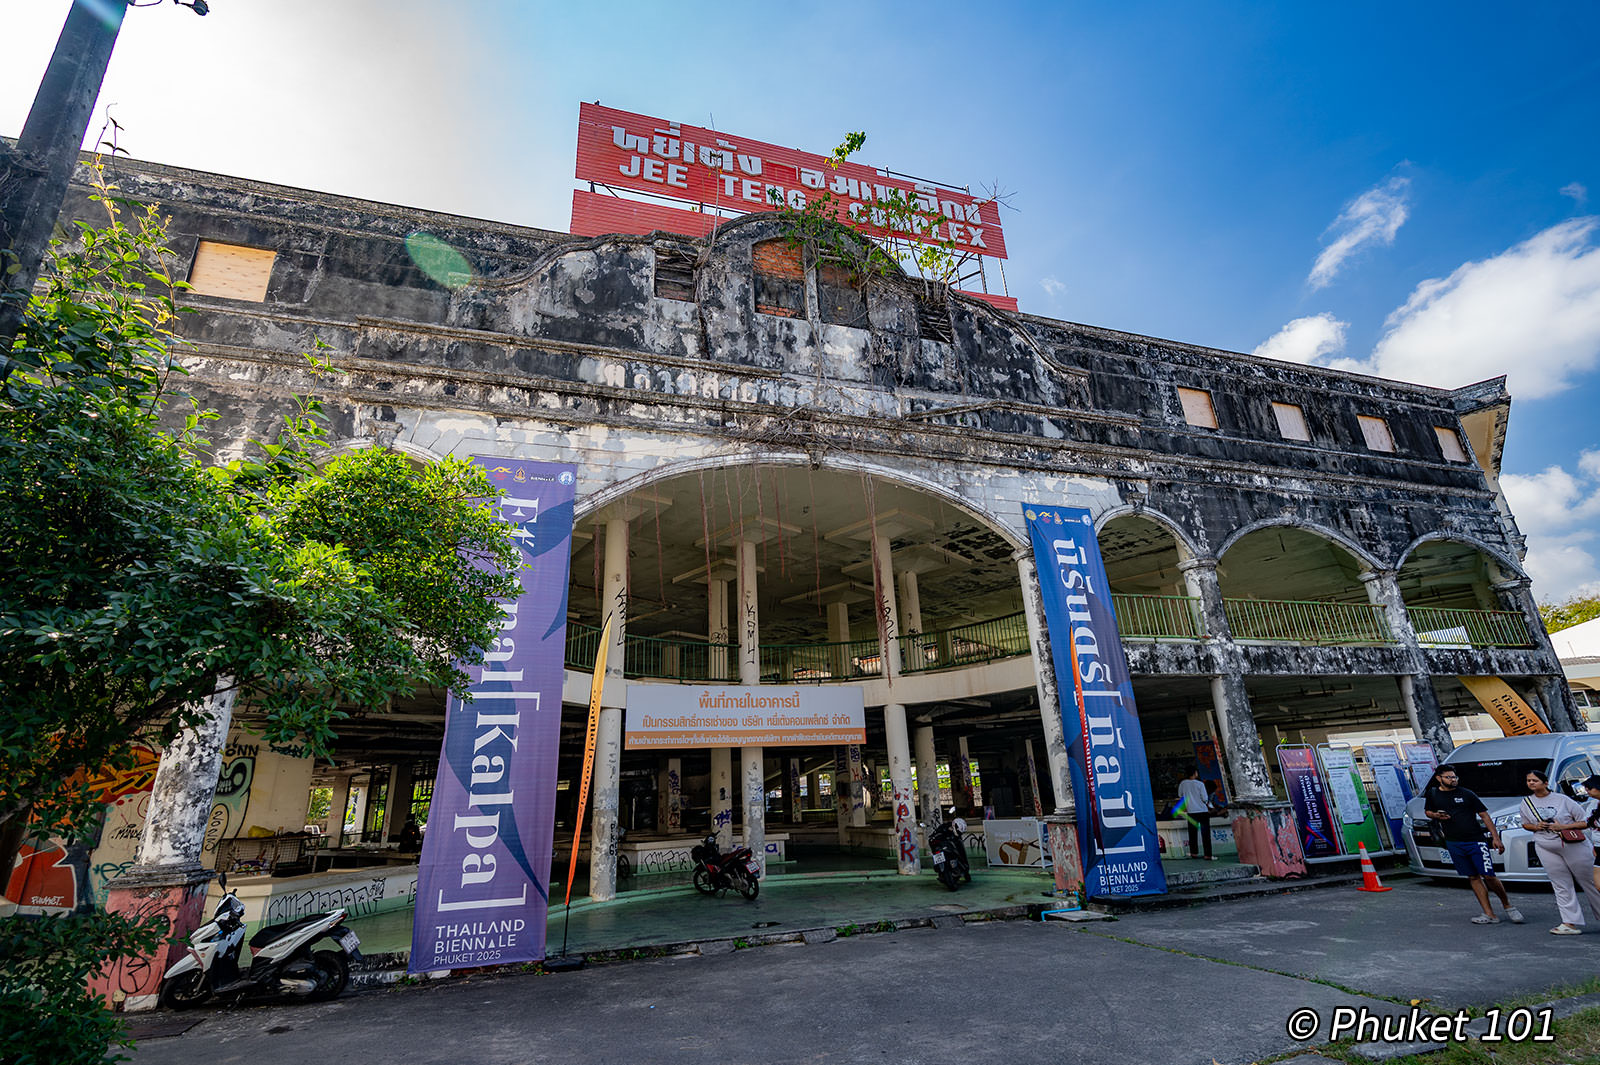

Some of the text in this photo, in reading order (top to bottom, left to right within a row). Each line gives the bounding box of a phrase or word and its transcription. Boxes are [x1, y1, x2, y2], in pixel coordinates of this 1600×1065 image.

[619, 155, 689, 189] JEE
[720, 174, 807, 211] TENG
[698, 690, 800, 709] พื้นที่ภายในอาคารนี้
[742, 714, 764, 727] บริษัท
[832, 713, 851, 725] จำกัด
[1096, 861, 1148, 875] THAILAND
[1099, 872, 1146, 887] BIENNALE
[1124, 884, 1140, 893] 2025
[435, 919, 525, 939] THAILAND
[434, 933, 516, 954] BIENNALE
[433, 950, 501, 966] PHUKET 2025
